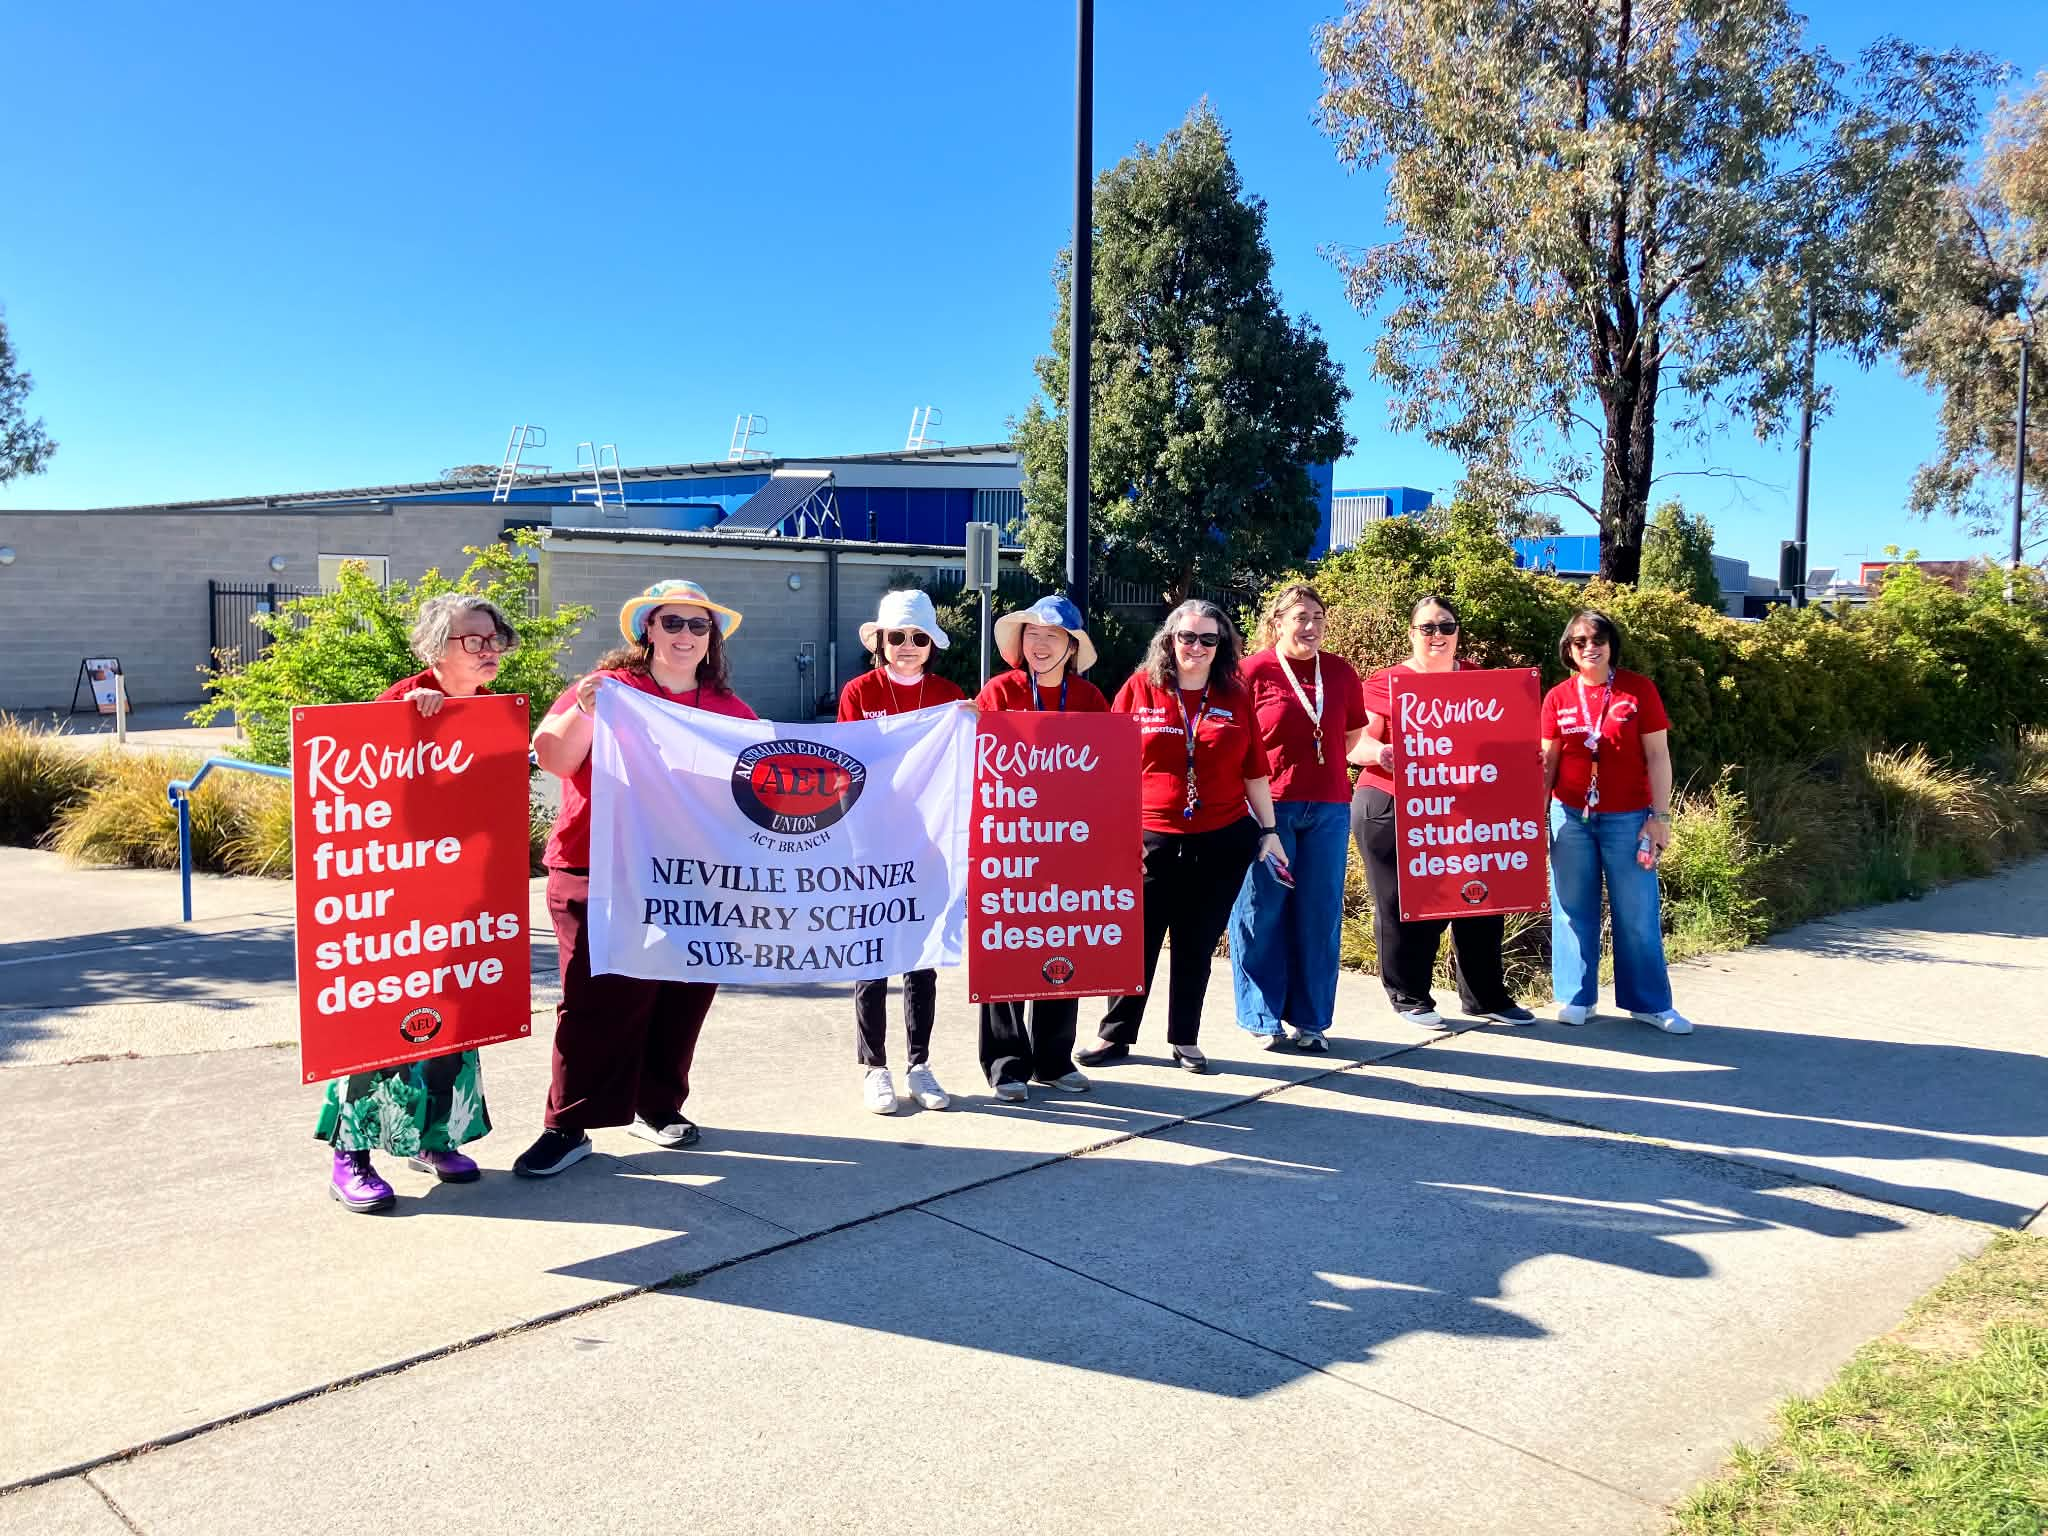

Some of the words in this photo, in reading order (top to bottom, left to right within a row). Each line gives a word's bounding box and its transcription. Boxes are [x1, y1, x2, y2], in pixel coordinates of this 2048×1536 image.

[1397, 692, 1504, 733] Resource
[1141, 726, 1184, 735] ducators
[1404, 731, 1453, 757] the
[303, 735, 475, 799] Resource
[797, 742, 865, 783] EDUCATION
[976, 733, 1099, 779] Resource
[758, 763, 841, 796] AEU
[1404, 762, 1498, 787] future
[979, 780, 1038, 809] the
[1406, 795, 1456, 817] our
[312, 795, 392, 835] the
[772, 814, 816, 832] UNION
[980, 815, 1089, 843] future
[749, 831, 776, 850] ACT
[778, 831, 831, 853] BRANCH
[1407, 818, 1538, 847] students
[313, 836, 462, 880] future
[980, 856, 1039, 879] our
[1409, 851, 1529, 877] deserve
[651, 856, 786, 893] NEVILLE
[796, 860, 917, 893] BONNER
[314, 888, 395, 925] our
[642, 898, 798, 930] PRIMARY
[807, 897, 925, 932] SCHOOL
[980, 884, 1135, 915] students
[315, 911, 520, 971] students
[981, 921, 1123, 950] deserve
[686, 937, 884, 970] SUB-BRANCH
[317, 957, 503, 1016] deserve
